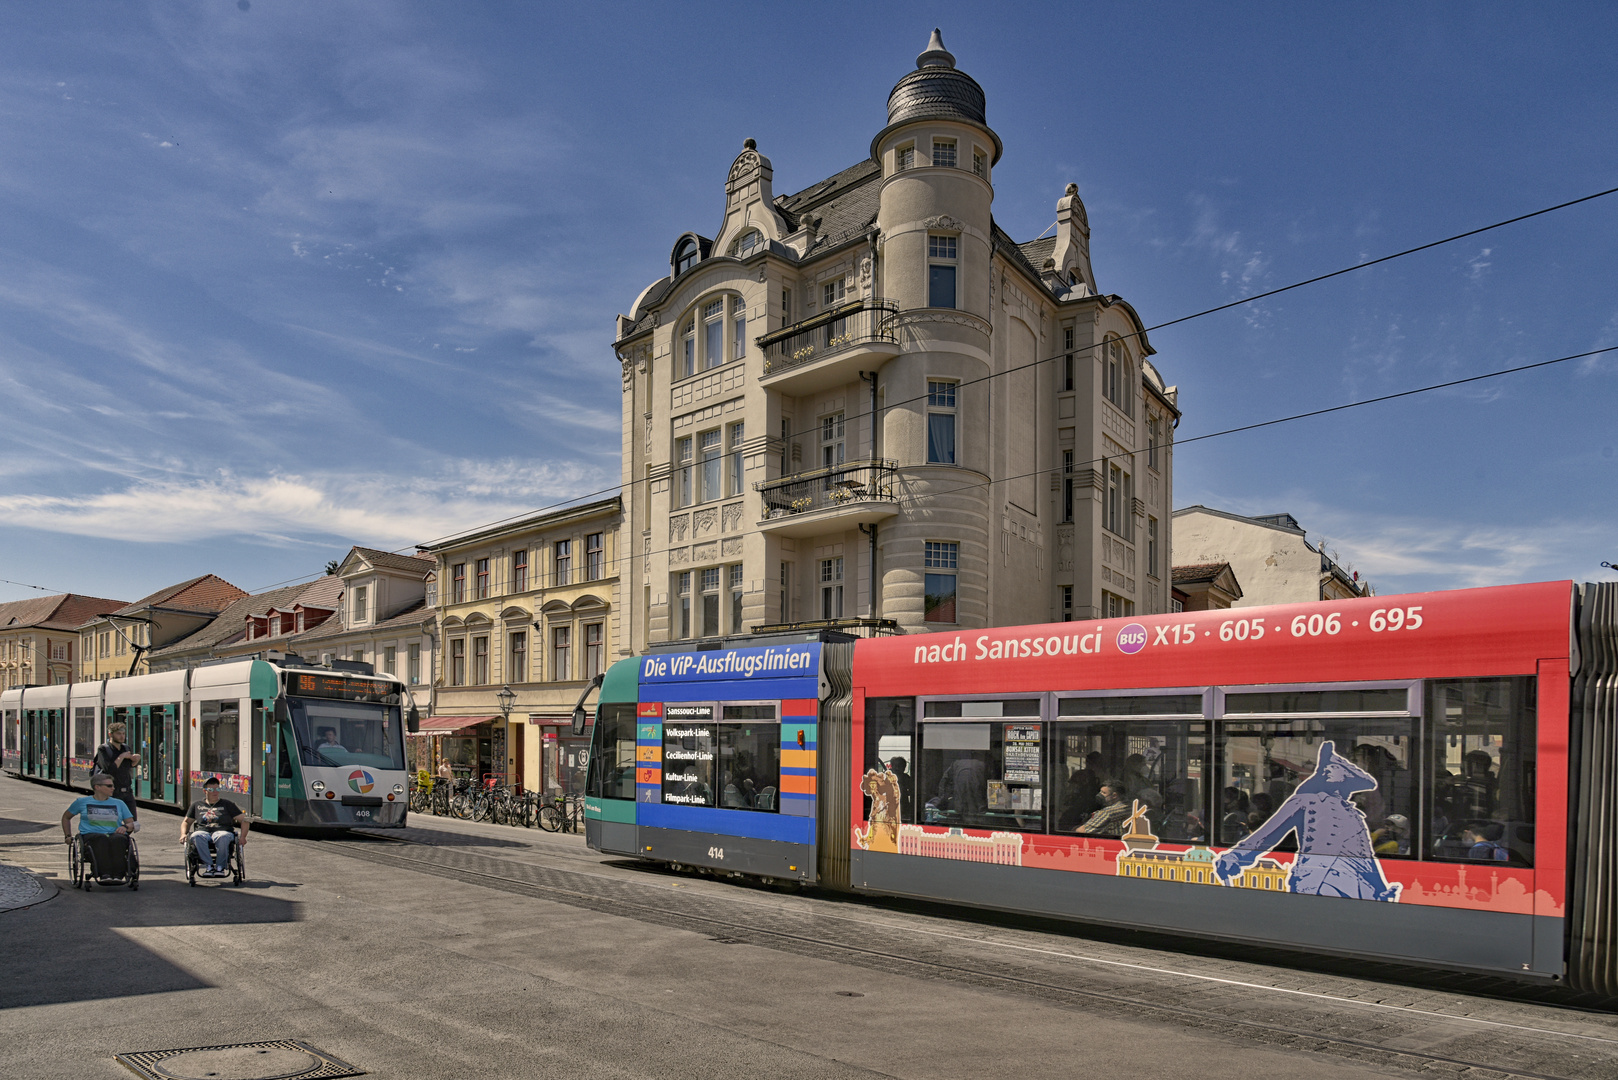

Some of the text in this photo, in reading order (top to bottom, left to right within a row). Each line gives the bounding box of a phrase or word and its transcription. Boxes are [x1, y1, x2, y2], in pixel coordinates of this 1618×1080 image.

[1153, 606, 1423, 646] X15 605 606 695
[914, 626, 1103, 663] nach Sanssouci
[1119, 632, 1145, 645] BUS
[644, 648, 811, 677] Die ViP-Ausflugslinien
[299, 674, 316, 690] 96
[667, 707, 711, 715] Sanssouci-Linie
[666, 728, 710, 738] Volkspark-Linie
[666, 751, 713, 760] Cecilienhof-Linie
[665, 772, 698, 782] Kultur-Linie
[665, 793, 705, 804] Filmpark-Linie
[707, 846, 724, 860] 414
